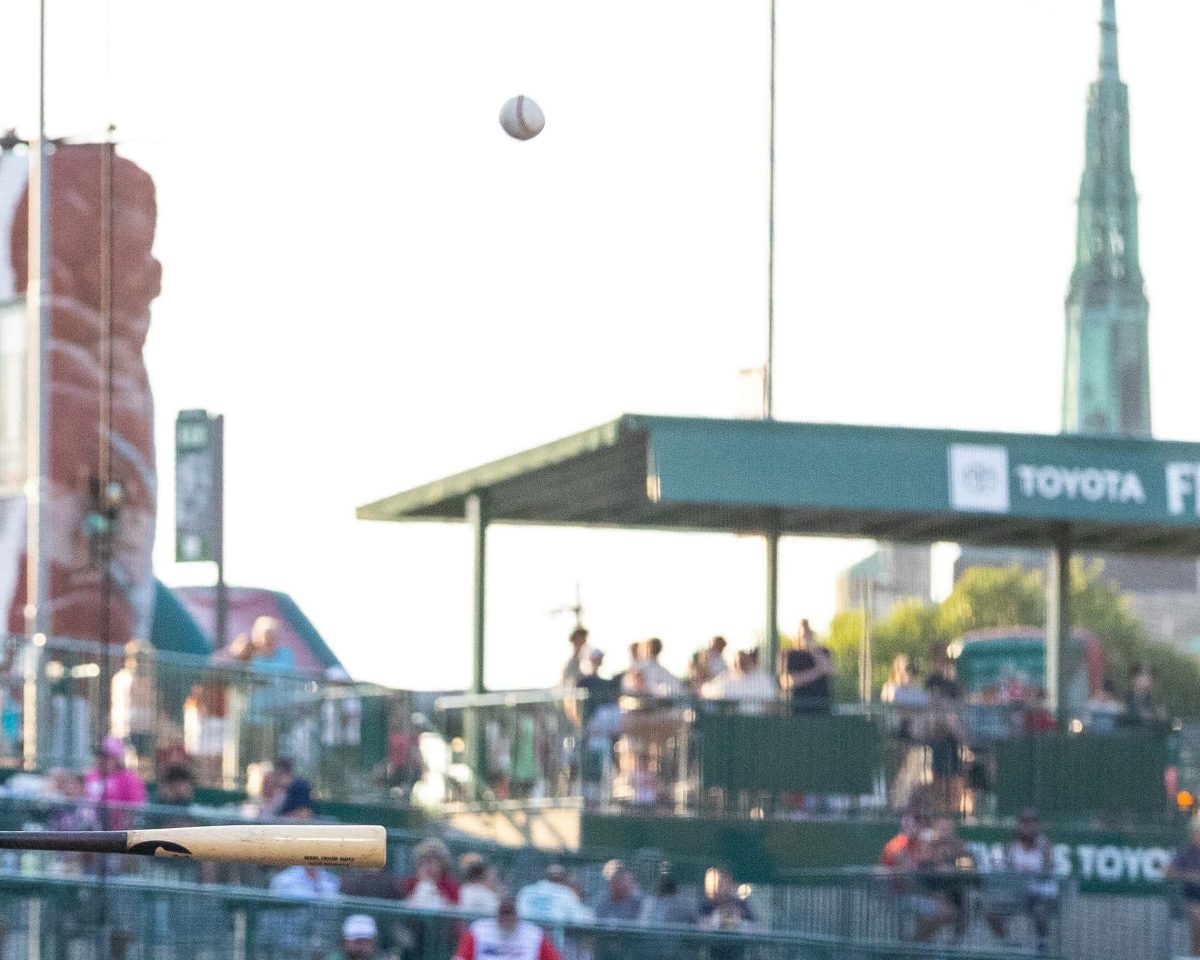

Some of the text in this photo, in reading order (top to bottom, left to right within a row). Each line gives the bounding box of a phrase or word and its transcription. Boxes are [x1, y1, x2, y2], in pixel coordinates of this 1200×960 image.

[1018, 463, 1200, 516] TOYOTA F
[1077, 843, 1175, 882] TOYO
